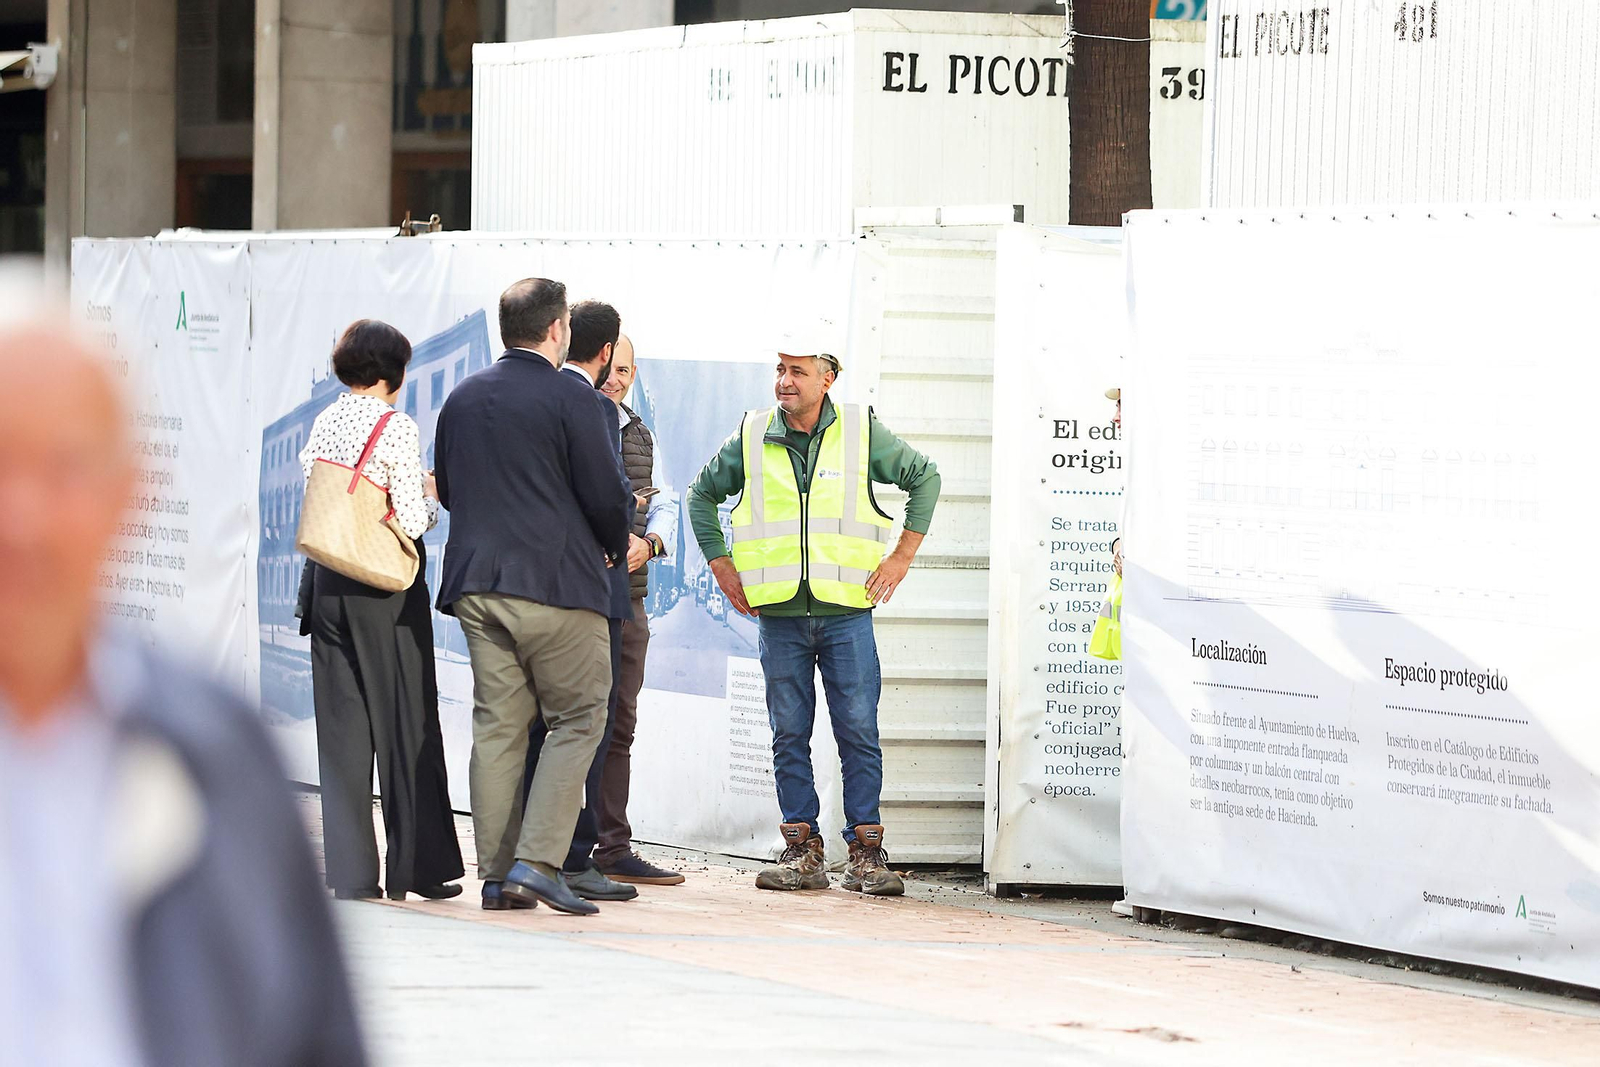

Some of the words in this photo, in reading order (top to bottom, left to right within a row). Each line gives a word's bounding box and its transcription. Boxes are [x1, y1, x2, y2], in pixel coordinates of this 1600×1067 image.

[882, 52, 927, 92] EL
[1053, 420, 1079, 439] El
[1051, 517, 1072, 530] Se
[1078, 519, 1118, 532] trata
[1049, 601, 1059, 614] y
[1066, 600, 1101, 613] 1953
[1049, 619, 1076, 632] dos
[1048, 642, 1076, 653] con
[1192, 638, 1267, 665] Localización
[1046, 680, 1108, 694] edificio
[1385, 658, 1436, 686] Espacio
[1440, 668, 1508, 694] protegido
[1045, 700, 1077, 714] Fue
[1083, 705, 1121, 718] proy
[1191, 708, 1220, 725] Situado
[1222, 712, 1247, 729] frente
[1249, 715, 1256, 729] al
[1259, 717, 1314, 737] Ayuntamiento
[1316, 724, 1326, 739] de
[1328, 725, 1360, 744] Huelva,
[1190, 733, 1204, 745] con
[1224, 734, 1265, 753] imponente
[1268, 742, 1299, 758] entrada
[1302, 744, 1348, 764] flanqueada
[1386, 732, 1419, 749] Inscrito
[1421, 739, 1432, 751] en
[1434, 738, 1442, 752] el
[1444, 739, 1484, 761] Catálogo
[1486, 745, 1497, 759] de
[1499, 746, 1539, 764] Edificios
[1045, 762, 1121, 776] neoherre
[1190, 754, 1203, 769] por
[1205, 755, 1242, 772] columnas
[1244, 763, 1250, 775] y
[1253, 762, 1263, 774] un
[1265, 761, 1291, 778] balcón
[1293, 769, 1322, 784] central
[1325, 773, 1340, 785] con
[1388, 755, 1434, 775] Protegidos
[1437, 761, 1447, 776] de
[1450, 762, 1457, 777] la
[1460, 763, 1495, 784] Ciudad,
[1498, 769, 1506, 784] el
[1508, 770, 1550, 790] inmueble
[1044, 782, 1096, 798] época.
[1190, 774, 1219, 791] detalles
[1222, 780, 1272, 799] neobarrocos,
[1275, 788, 1294, 801] tenía
[1297, 792, 1319, 805] como
[1321, 792, 1353, 811] objetivo
[1387, 779, 1436, 797] conservará
[1501, 795, 1511, 808] su
[1514, 795, 1554, 814] fachada.
[1190, 798, 1203, 809] ser
[1204, 797, 1212, 811] la
[1213, 800, 1244, 818] antigua
[1246, 804, 1264, 819] sede
[1266, 806, 1276, 820] de
[1278, 808, 1318, 827] Hacienda.
[1423, 891, 1444, 905] Somos
[1446, 896, 1469, 909] nuestro
[1470, 901, 1505, 915] patrimonio
